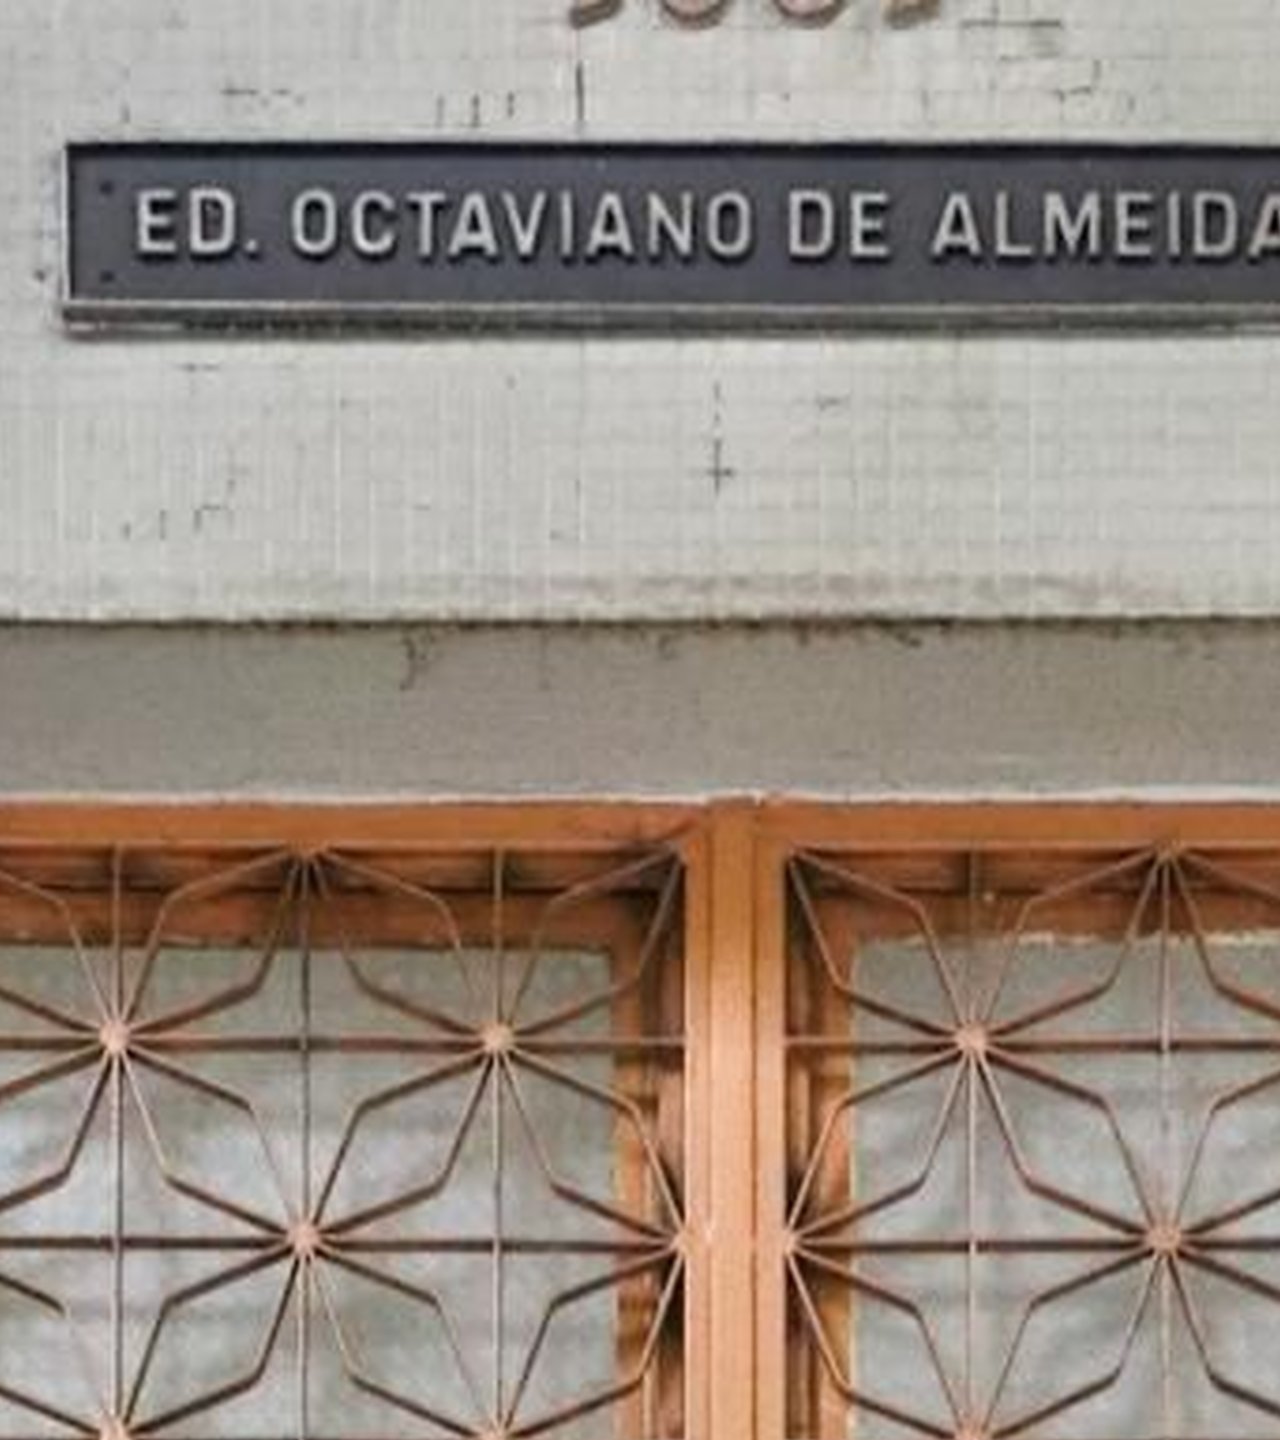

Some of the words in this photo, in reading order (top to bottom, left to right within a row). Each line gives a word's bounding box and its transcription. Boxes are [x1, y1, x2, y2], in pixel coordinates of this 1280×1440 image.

[135, 187, 259, 254] ED.
[290, 188, 751, 255] OCTAVIANO
[787, 188, 889, 257] DE
